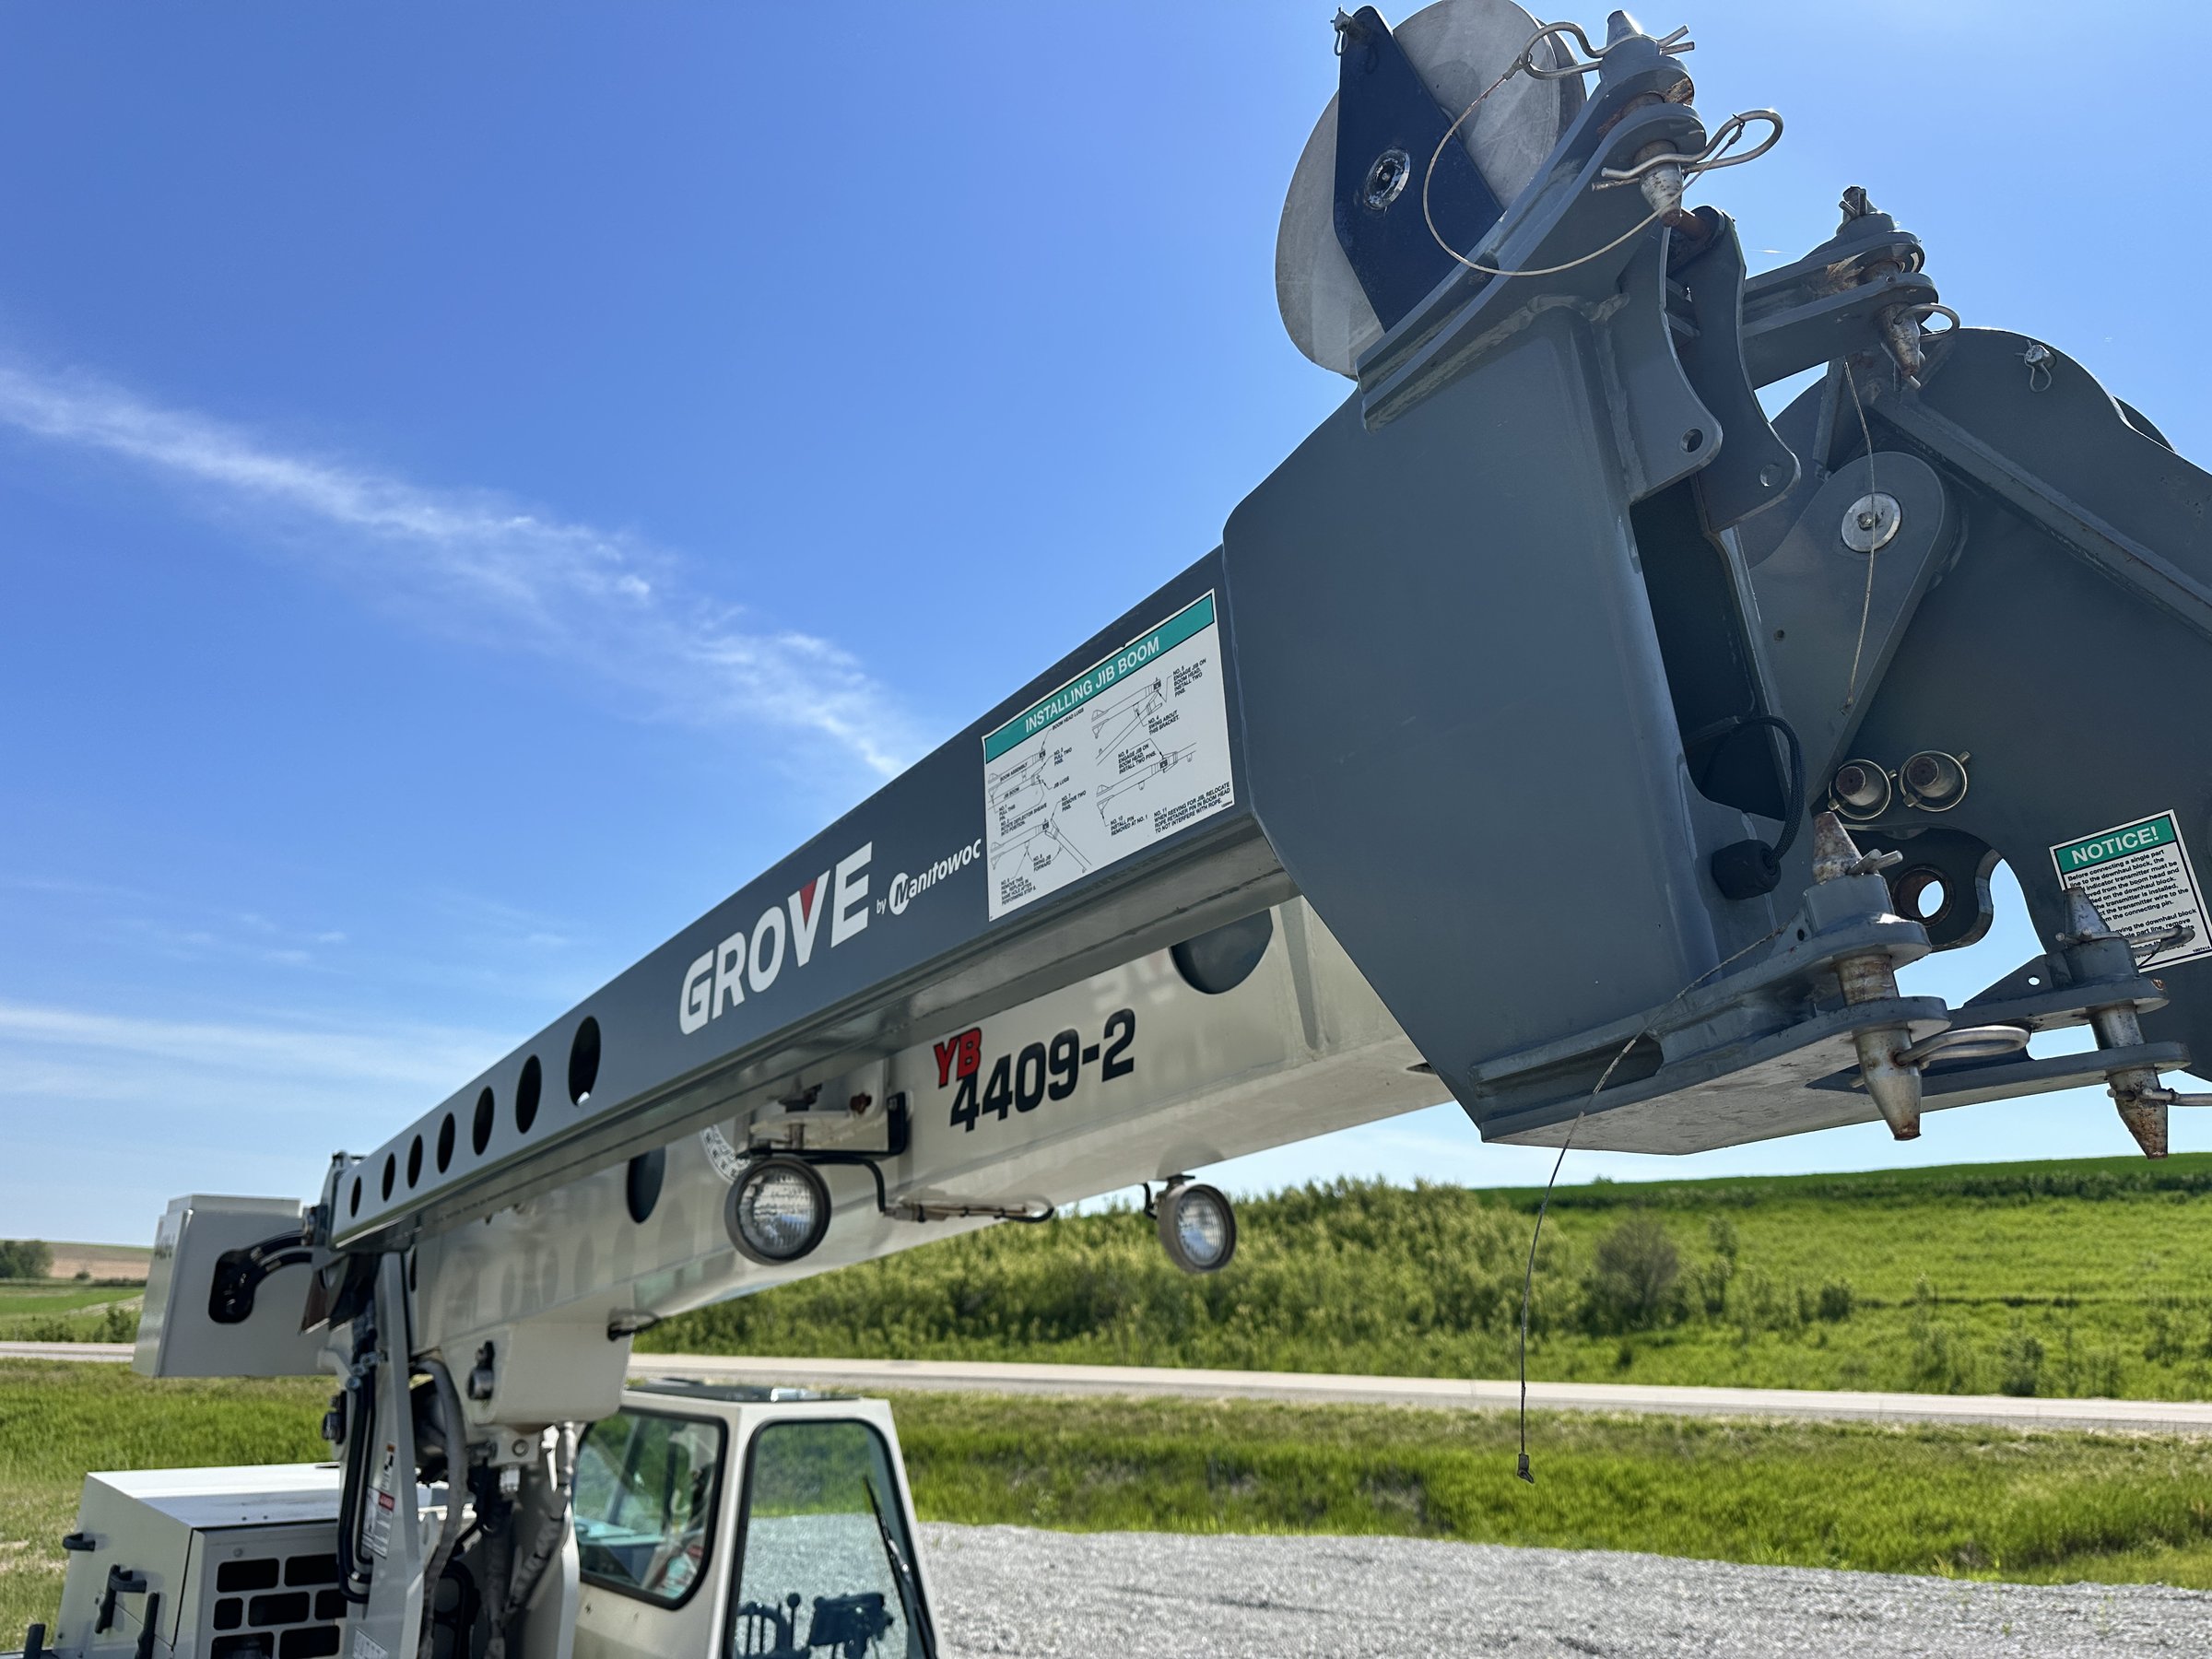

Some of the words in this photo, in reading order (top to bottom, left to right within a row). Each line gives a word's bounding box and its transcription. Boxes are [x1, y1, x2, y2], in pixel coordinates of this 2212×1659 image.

[1174, 666, 1191, 681] ENGAGE
[1174, 675, 1187, 687] BOOM
[1174, 678, 1192, 691] INSTALL
[1192, 672, 1203, 681] TWO
[1025, 680, 1093, 733] INSTALLING
[1095, 665, 1115, 688] JIB
[1118, 636, 1159, 676] BOOM
[1053, 720, 1064, 730] BOOM
[1149, 719, 1162, 730] SWING
[1163, 710, 1177, 722] ABOUT
[1149, 726, 1159, 735] THIS
[1064, 747, 1073, 756] TWO
[1119, 751, 1135, 763] ENGAGE
[1119, 759, 1132, 769] BOOM
[1119, 762, 1135, 774] INSTALL
[1135, 757, 1145, 765] TWO
[1000, 773, 1010, 782] BOOM
[1062, 794, 1077, 806] REMOVE
[1077, 790, 1087, 798] TWO
[1154, 813, 1168, 822] WHEN
[1168, 803, 1187, 816] REEVING
[1187, 798, 1197, 807] FOR
[1206, 782, 1230, 797] RELOCATE
[1155, 819, 1167, 829] ROPE
[1167, 808, 1188, 822] RETAINER
[1203, 794, 1217, 806] BOOM
[1218, 788, 1230, 798] HEAD
[1111, 818, 1126, 831] INSTALL
[1162, 822, 1171, 831] NOT
[1171, 811, 1195, 827] INTERFERE
[1196, 806, 1208, 815] WITH
[1112, 822, 1131, 836] REMOVED
[2071, 826, 2159, 865] NOTICE!
[1033, 860, 1052, 872] FORWARD
[2067, 871, 2088, 881] Before
[2089, 862, 2124, 876] connecting
[2131, 853, 2150, 863] single
[2151, 849, 2165, 858] part
[2101, 866, 2132, 879] downhaul
[2133, 861, 2153, 870] block,
[876, 897, 887, 915] by
[888, 838, 982, 916] Manitowoc
[2087, 878, 2113, 891] indicator
[2114, 868, 2150, 882] transmitter
[2151, 864, 2168, 872] must
[2102, 885, 2117, 893] from
[2129, 877, 2148, 886] boom
[2149, 871, 2166, 880] head
[1021, 882, 1032, 891] AFTER
[2124, 882, 2156, 895] downhaul
[2156, 877, 2177, 886] block.
[2106, 894, 2140, 907] transmitter
[2118, 898, 2153, 911] transmitter
[2124, 903, 2160, 917] connecting
[2146, 912, 2177, 926] downhaul
[2177, 908, 2197, 918] block
[2166, 918, 2191, 928] remove
[679, 841, 873, 1035] GROVE
[934, 1027, 982, 1089] YB
[950, 1008, 1135, 1133] 4409-2
